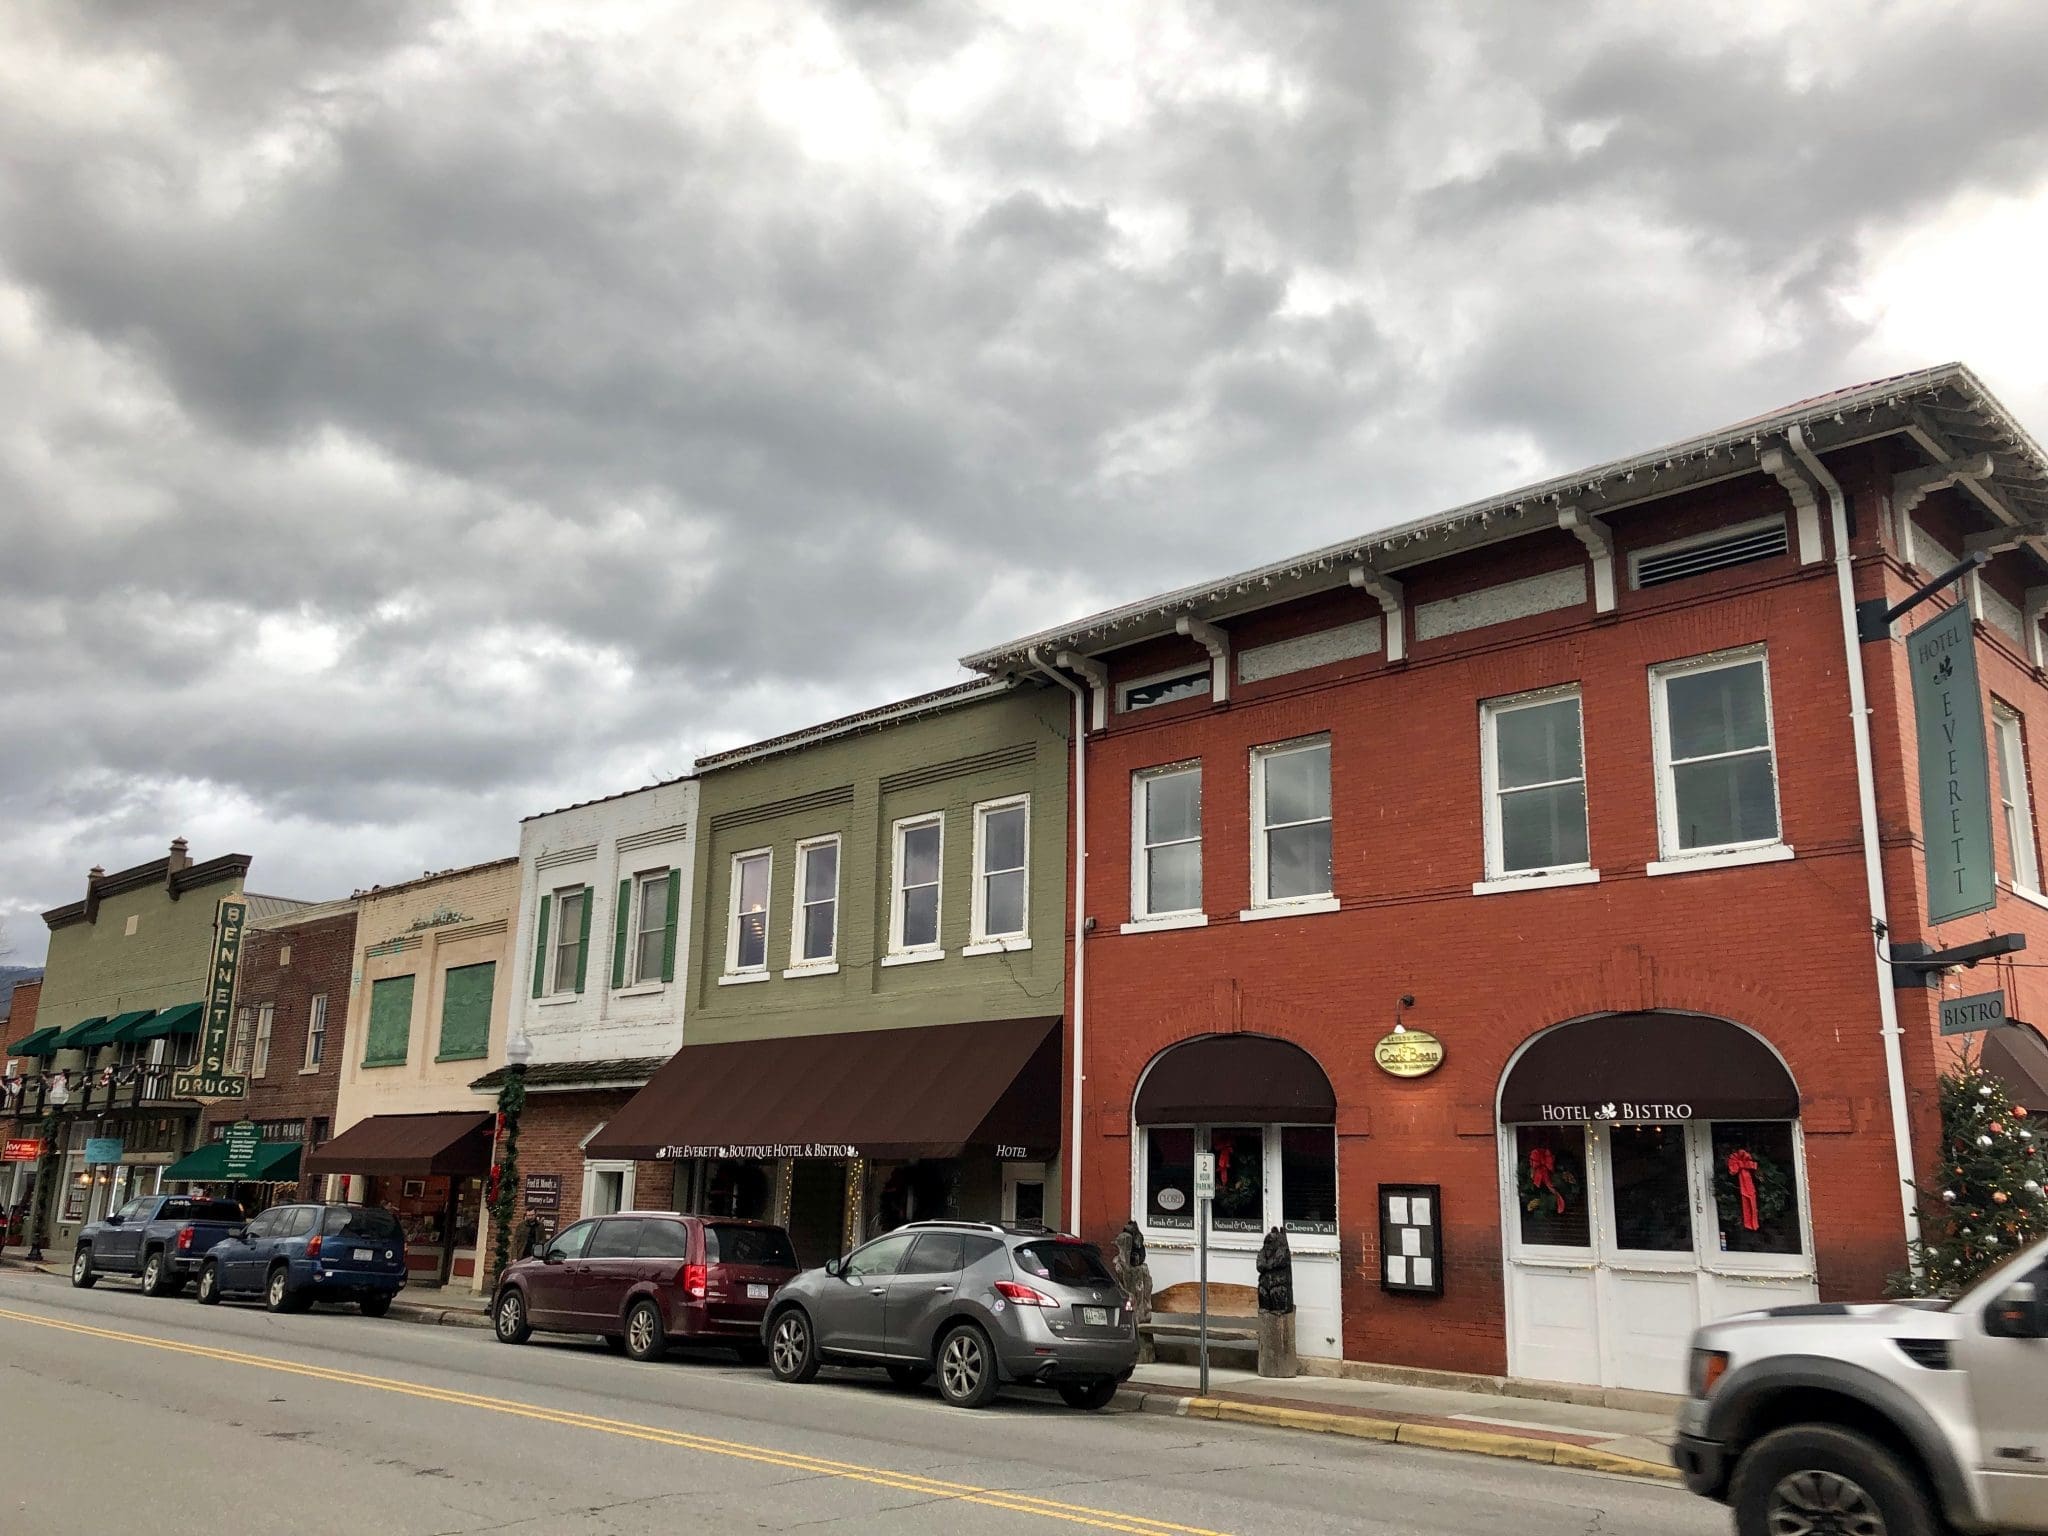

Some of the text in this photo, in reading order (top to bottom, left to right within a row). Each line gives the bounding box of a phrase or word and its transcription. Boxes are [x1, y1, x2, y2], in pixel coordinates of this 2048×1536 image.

[1919, 625, 1962, 665] HOTEL
[1941, 691, 1966, 896] EVERETT
[1944, 1000, 2002, 1027] BISTRO
[178, 1077, 244, 1095] DRUGS
[1541, 1102, 1693, 1121] HOTEL BISTRO
[667, 1143, 847, 1160] THE EVERETT BOUTIQUE HOTEL & BISTRO
[995, 1144, 1028, 1158] HOTEL
[1202, 1161, 1208, 1172] 2
[1160, 1193, 1184, 1204] CLOSED
[1149, 1217, 1166, 1226] Fresh
[1175, 1218, 1193, 1228] Local
[1214, 1219, 1233, 1230] Natural
[1240, 1220, 1262, 1231] Organic
[1285, 1222, 1314, 1233] Cheers
